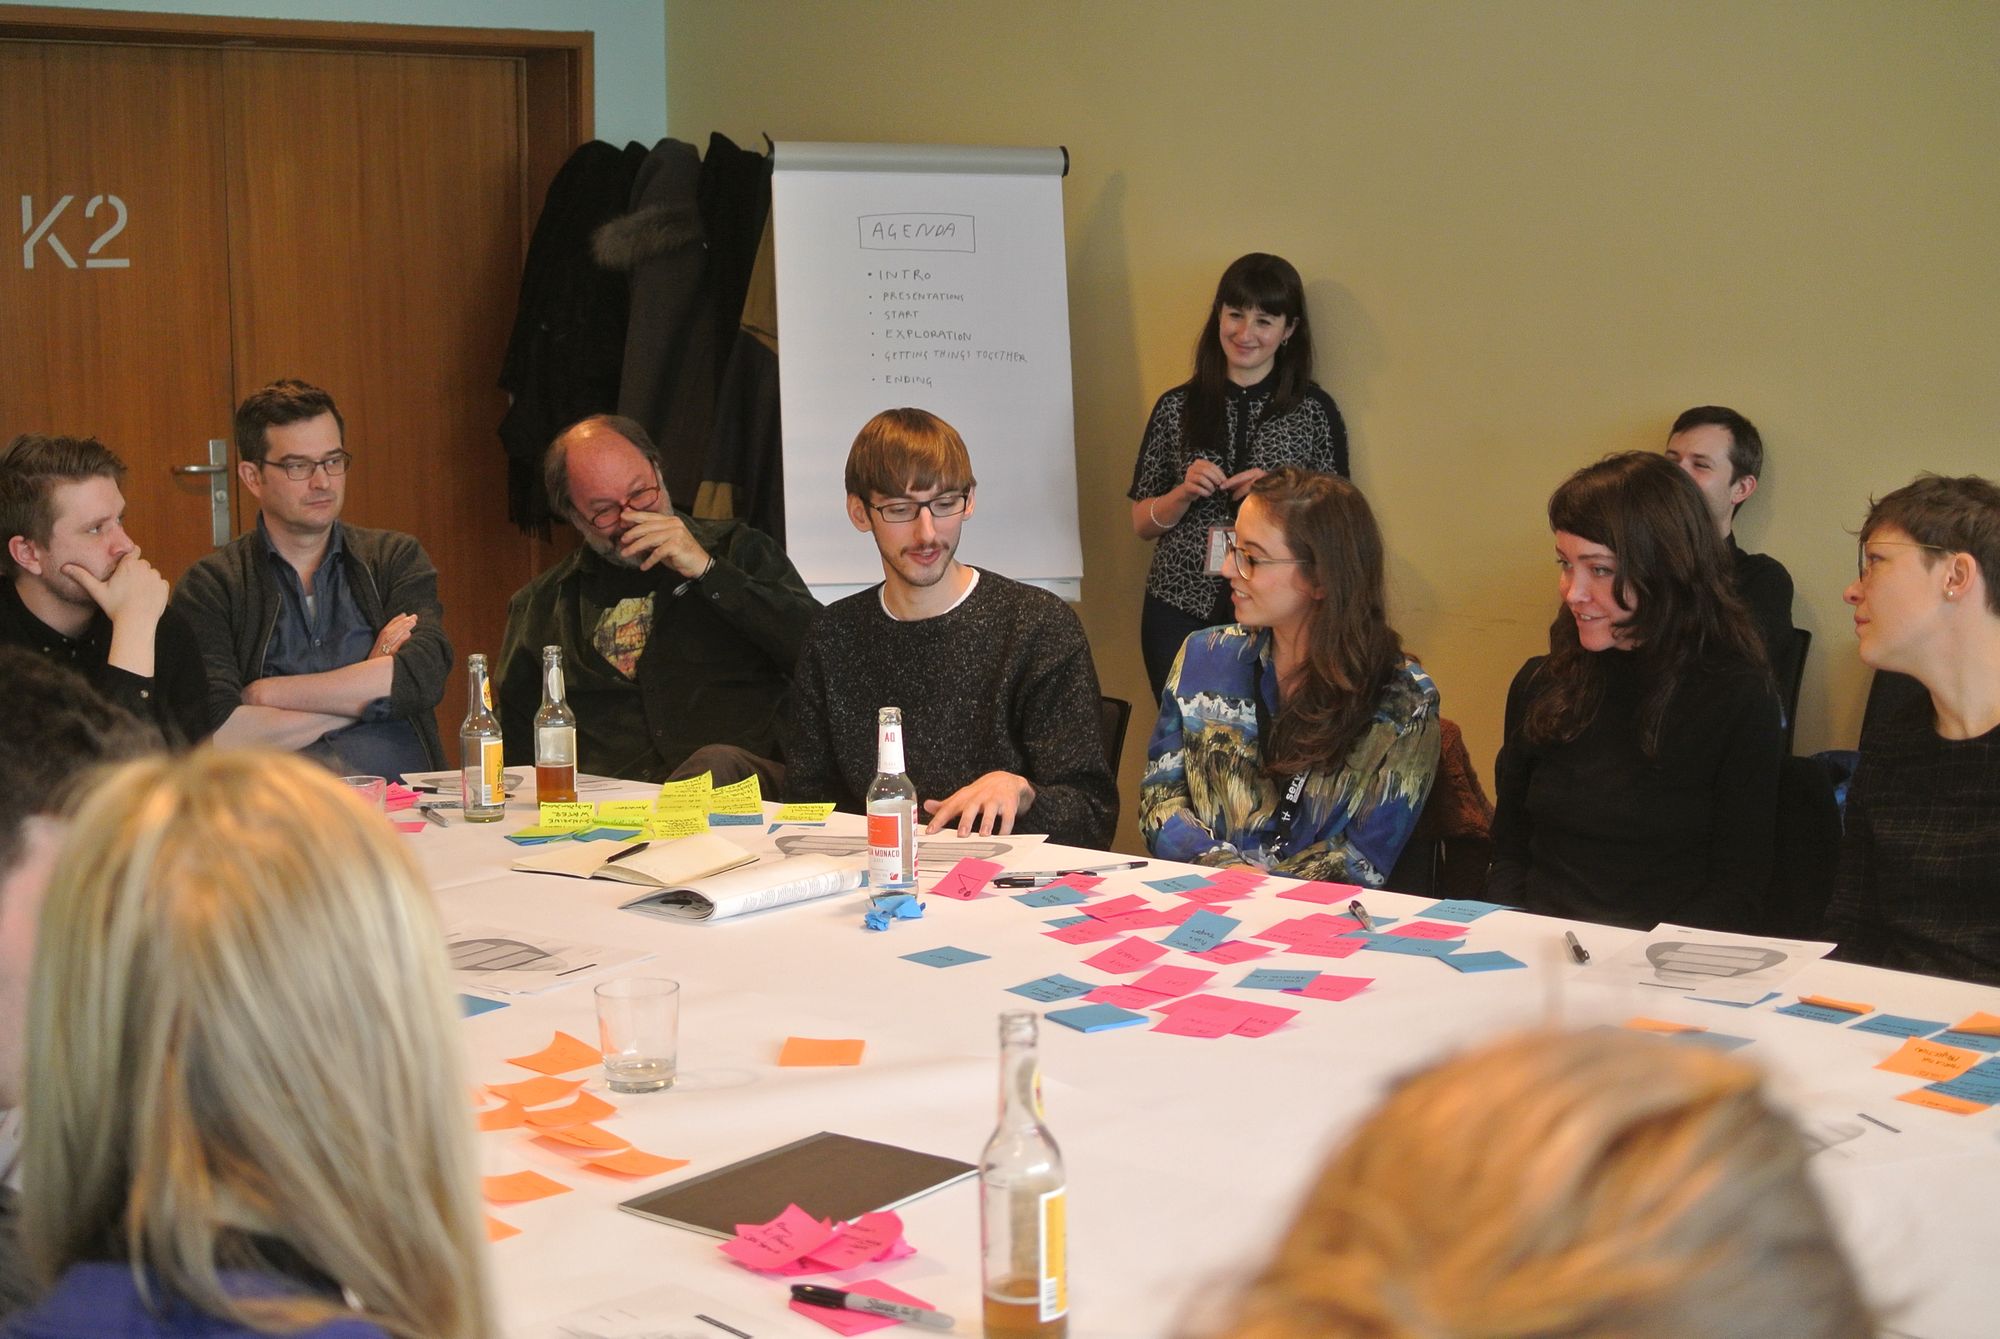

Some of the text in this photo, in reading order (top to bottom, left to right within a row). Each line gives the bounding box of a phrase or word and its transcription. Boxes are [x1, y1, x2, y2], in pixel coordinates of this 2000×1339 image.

[22, 194, 131, 269] K2
[871, 221, 957, 241] AGENDA
[879, 269, 932, 281] INTRO
[883, 291, 965, 302] PRESENTATIONS
[884, 310, 920, 320] START
[885, 329, 972, 342] EXPLORATION
[884, 351, 929, 362] GETTING
[976, 350, 1028, 363] TOGETHER
[885, 375, 933, 388] ENDING
[874, 848, 900, 858] MONACO
